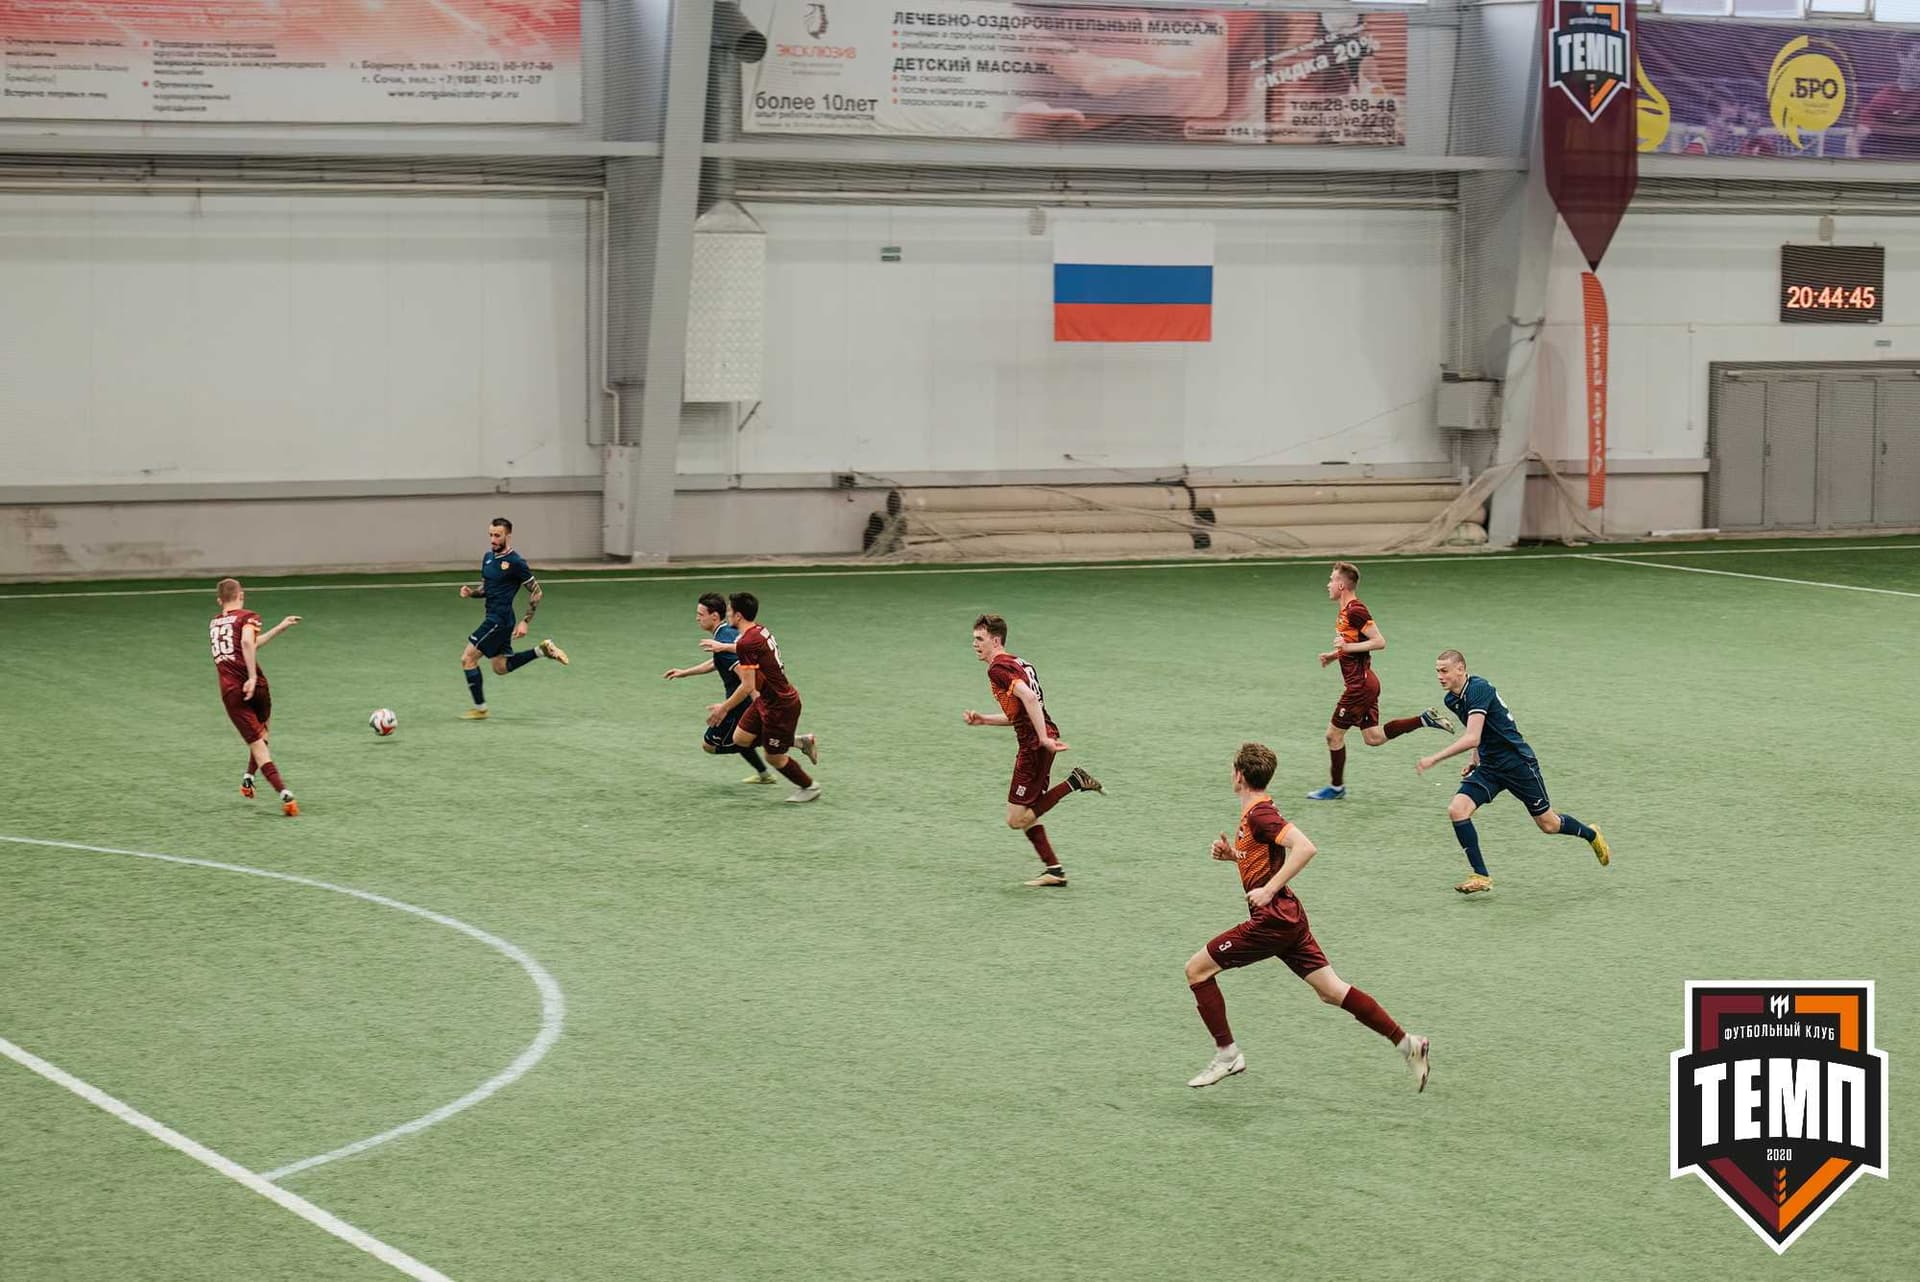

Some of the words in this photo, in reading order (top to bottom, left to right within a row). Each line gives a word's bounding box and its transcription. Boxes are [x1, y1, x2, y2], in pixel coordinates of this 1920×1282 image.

[893, 11, 1144, 32] ЛЕЧЕБНО-ОЗДОРОВИТЕЛЬНЫЙ
[1147, 20, 1224, 36] МАССАЖ:
[776, 44, 857, 59] ЭКСКЛЮЗИВ
[1253, 54, 1331, 89] скидка
[1333, 32, 1381, 64] 20%
[1558, 32, 1624, 75] ТЕМП
[892, 56, 971, 73] ДЕТСКИЙ
[976, 60, 1055, 75] МАССАЖ:
[754, 91, 815, 110] более
[822, 93, 879, 112] 10лет
[1787, 286, 1876, 309] 20:44:45
[209, 624, 235, 657] 33
[1218, 940, 1232, 952] 3
